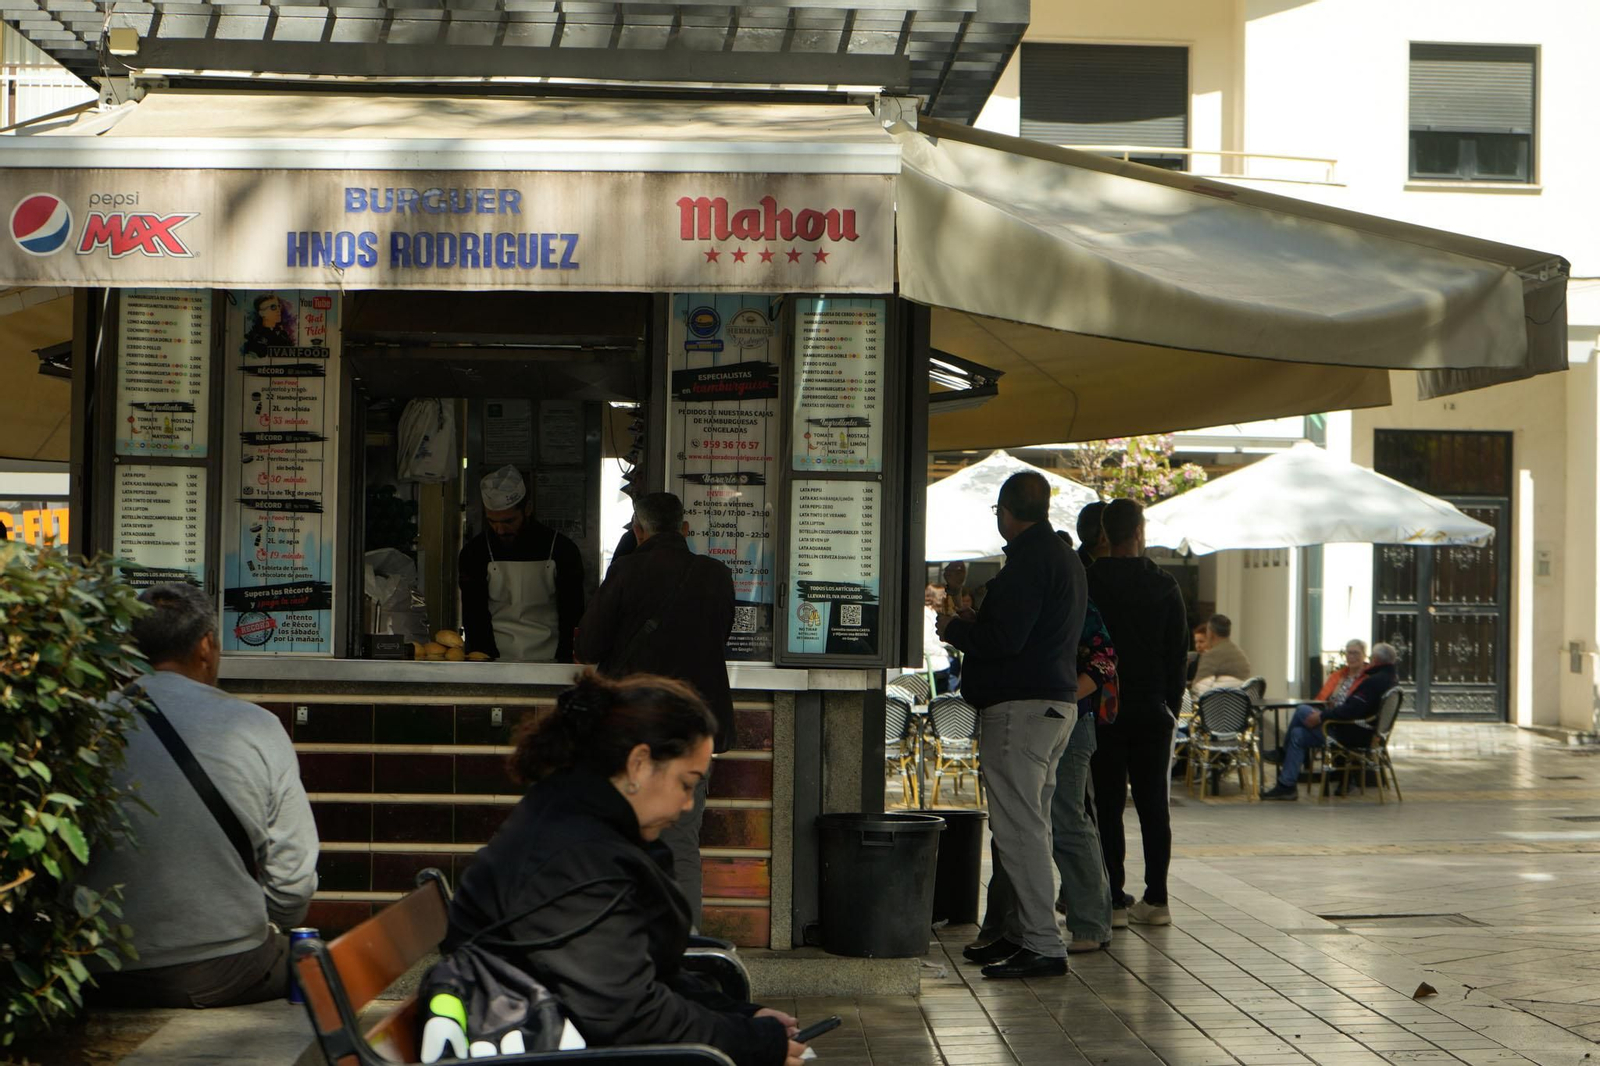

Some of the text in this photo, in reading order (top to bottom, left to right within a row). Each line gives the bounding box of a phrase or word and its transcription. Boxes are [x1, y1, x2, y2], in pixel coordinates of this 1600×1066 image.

[89, 192, 140, 209] pepsi
[344, 187, 522, 214] BURGUER
[676, 195, 860, 242] Mahou
[79, 212, 196, 258] MAX
[286, 231, 580, 270] HNOS RODRIGUEZ
[698, 371, 752, 381] ESPECIALISTAS
[703, 440, 759, 450] 959 36 76 57
[270, 475, 281, 483] 30
[702, 474, 736, 483] Horario
[244, 590, 270, 598] Supera
[284, 587, 313, 595] Récords
